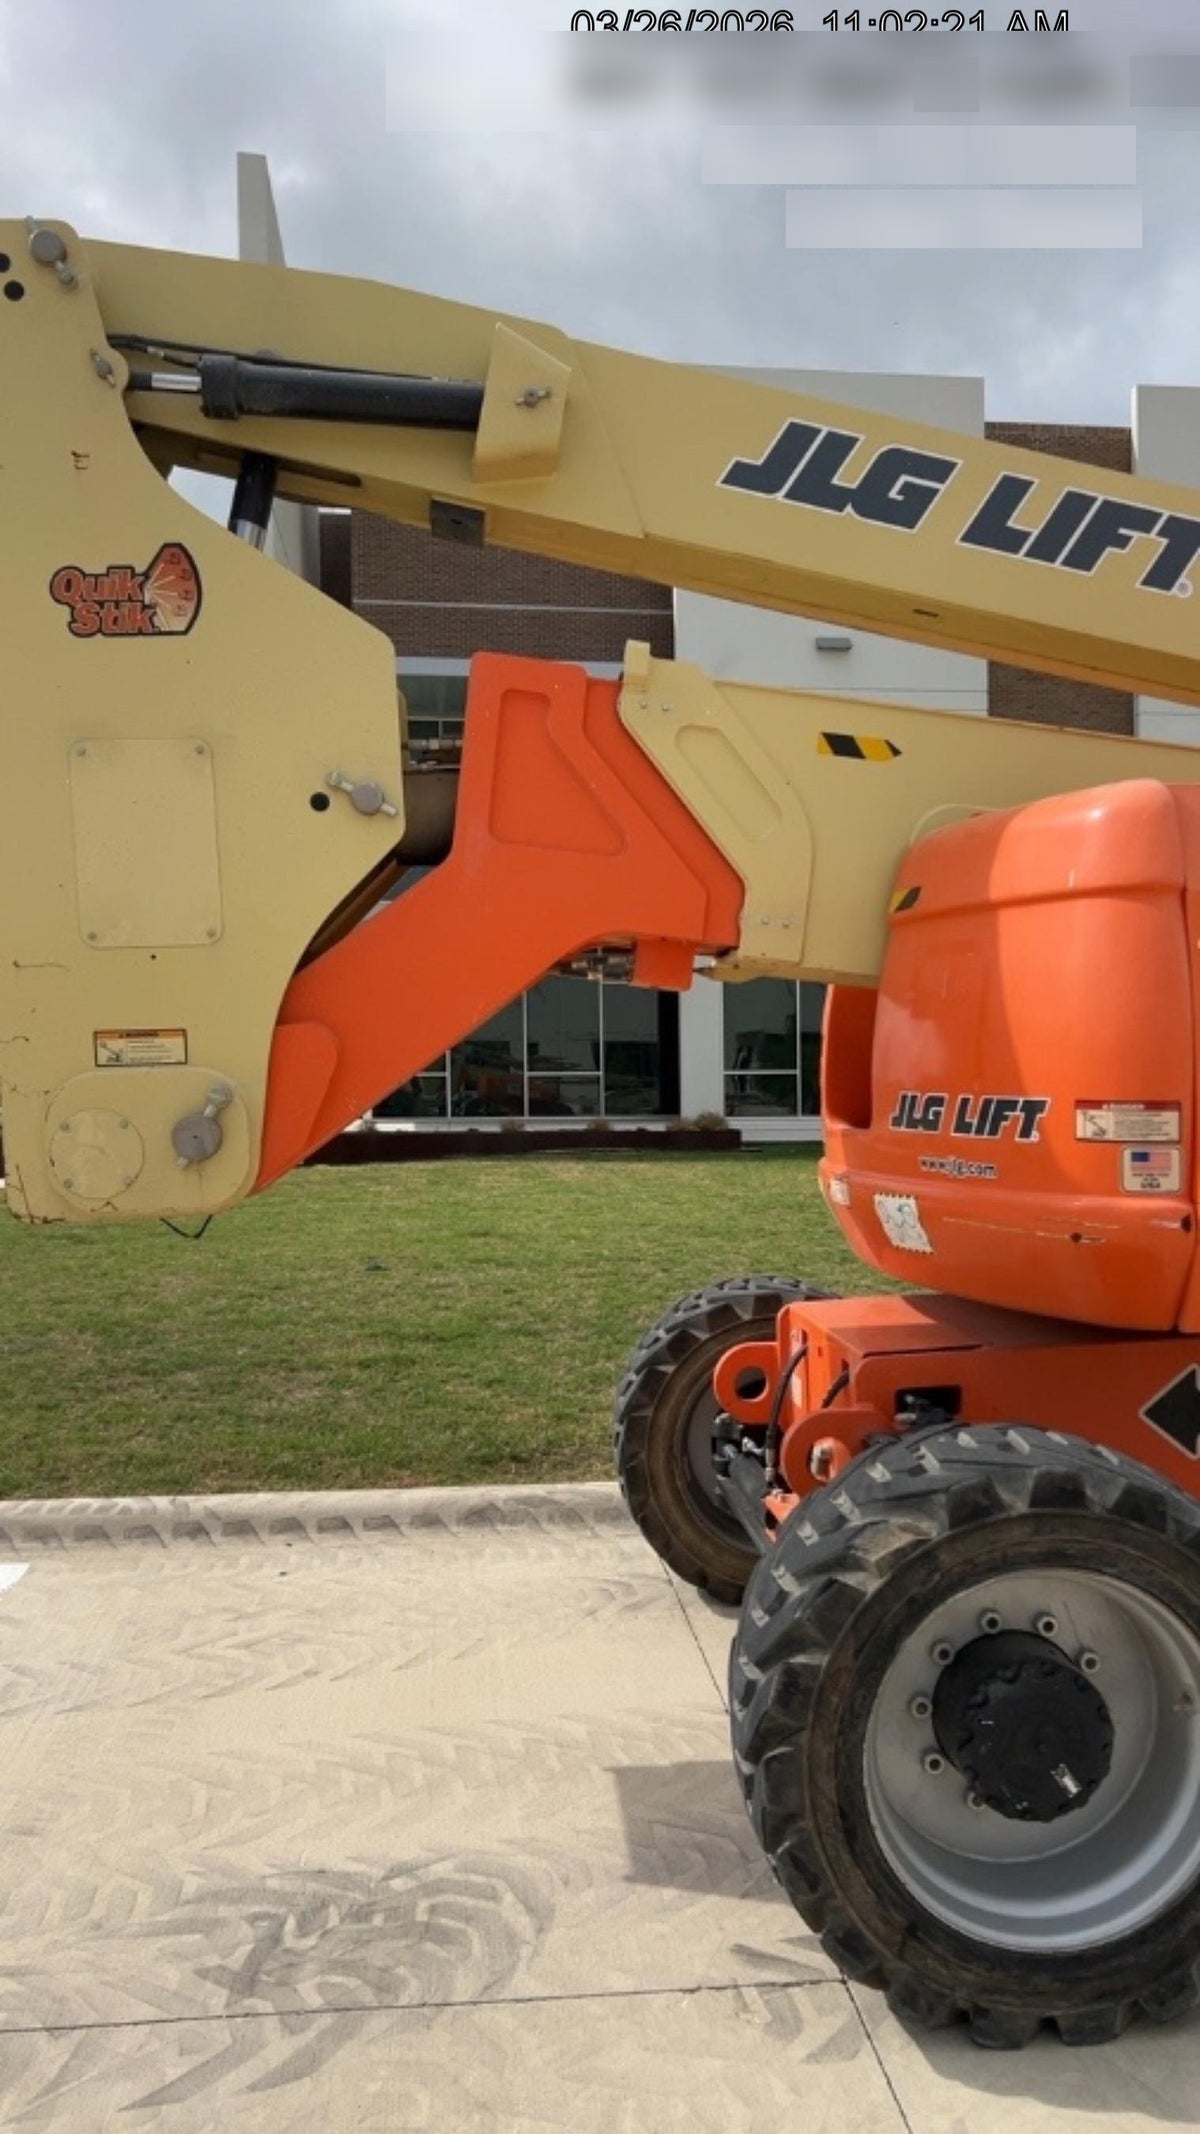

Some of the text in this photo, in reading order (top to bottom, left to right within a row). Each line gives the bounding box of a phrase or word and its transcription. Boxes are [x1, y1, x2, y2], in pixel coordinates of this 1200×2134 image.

[716, 418, 1200, 597] JLG LIFT
[51, 568, 146, 605] Quik
[70, 600, 158, 635] Stik
[889, 1091, 1051, 1142] JLG LIFT
